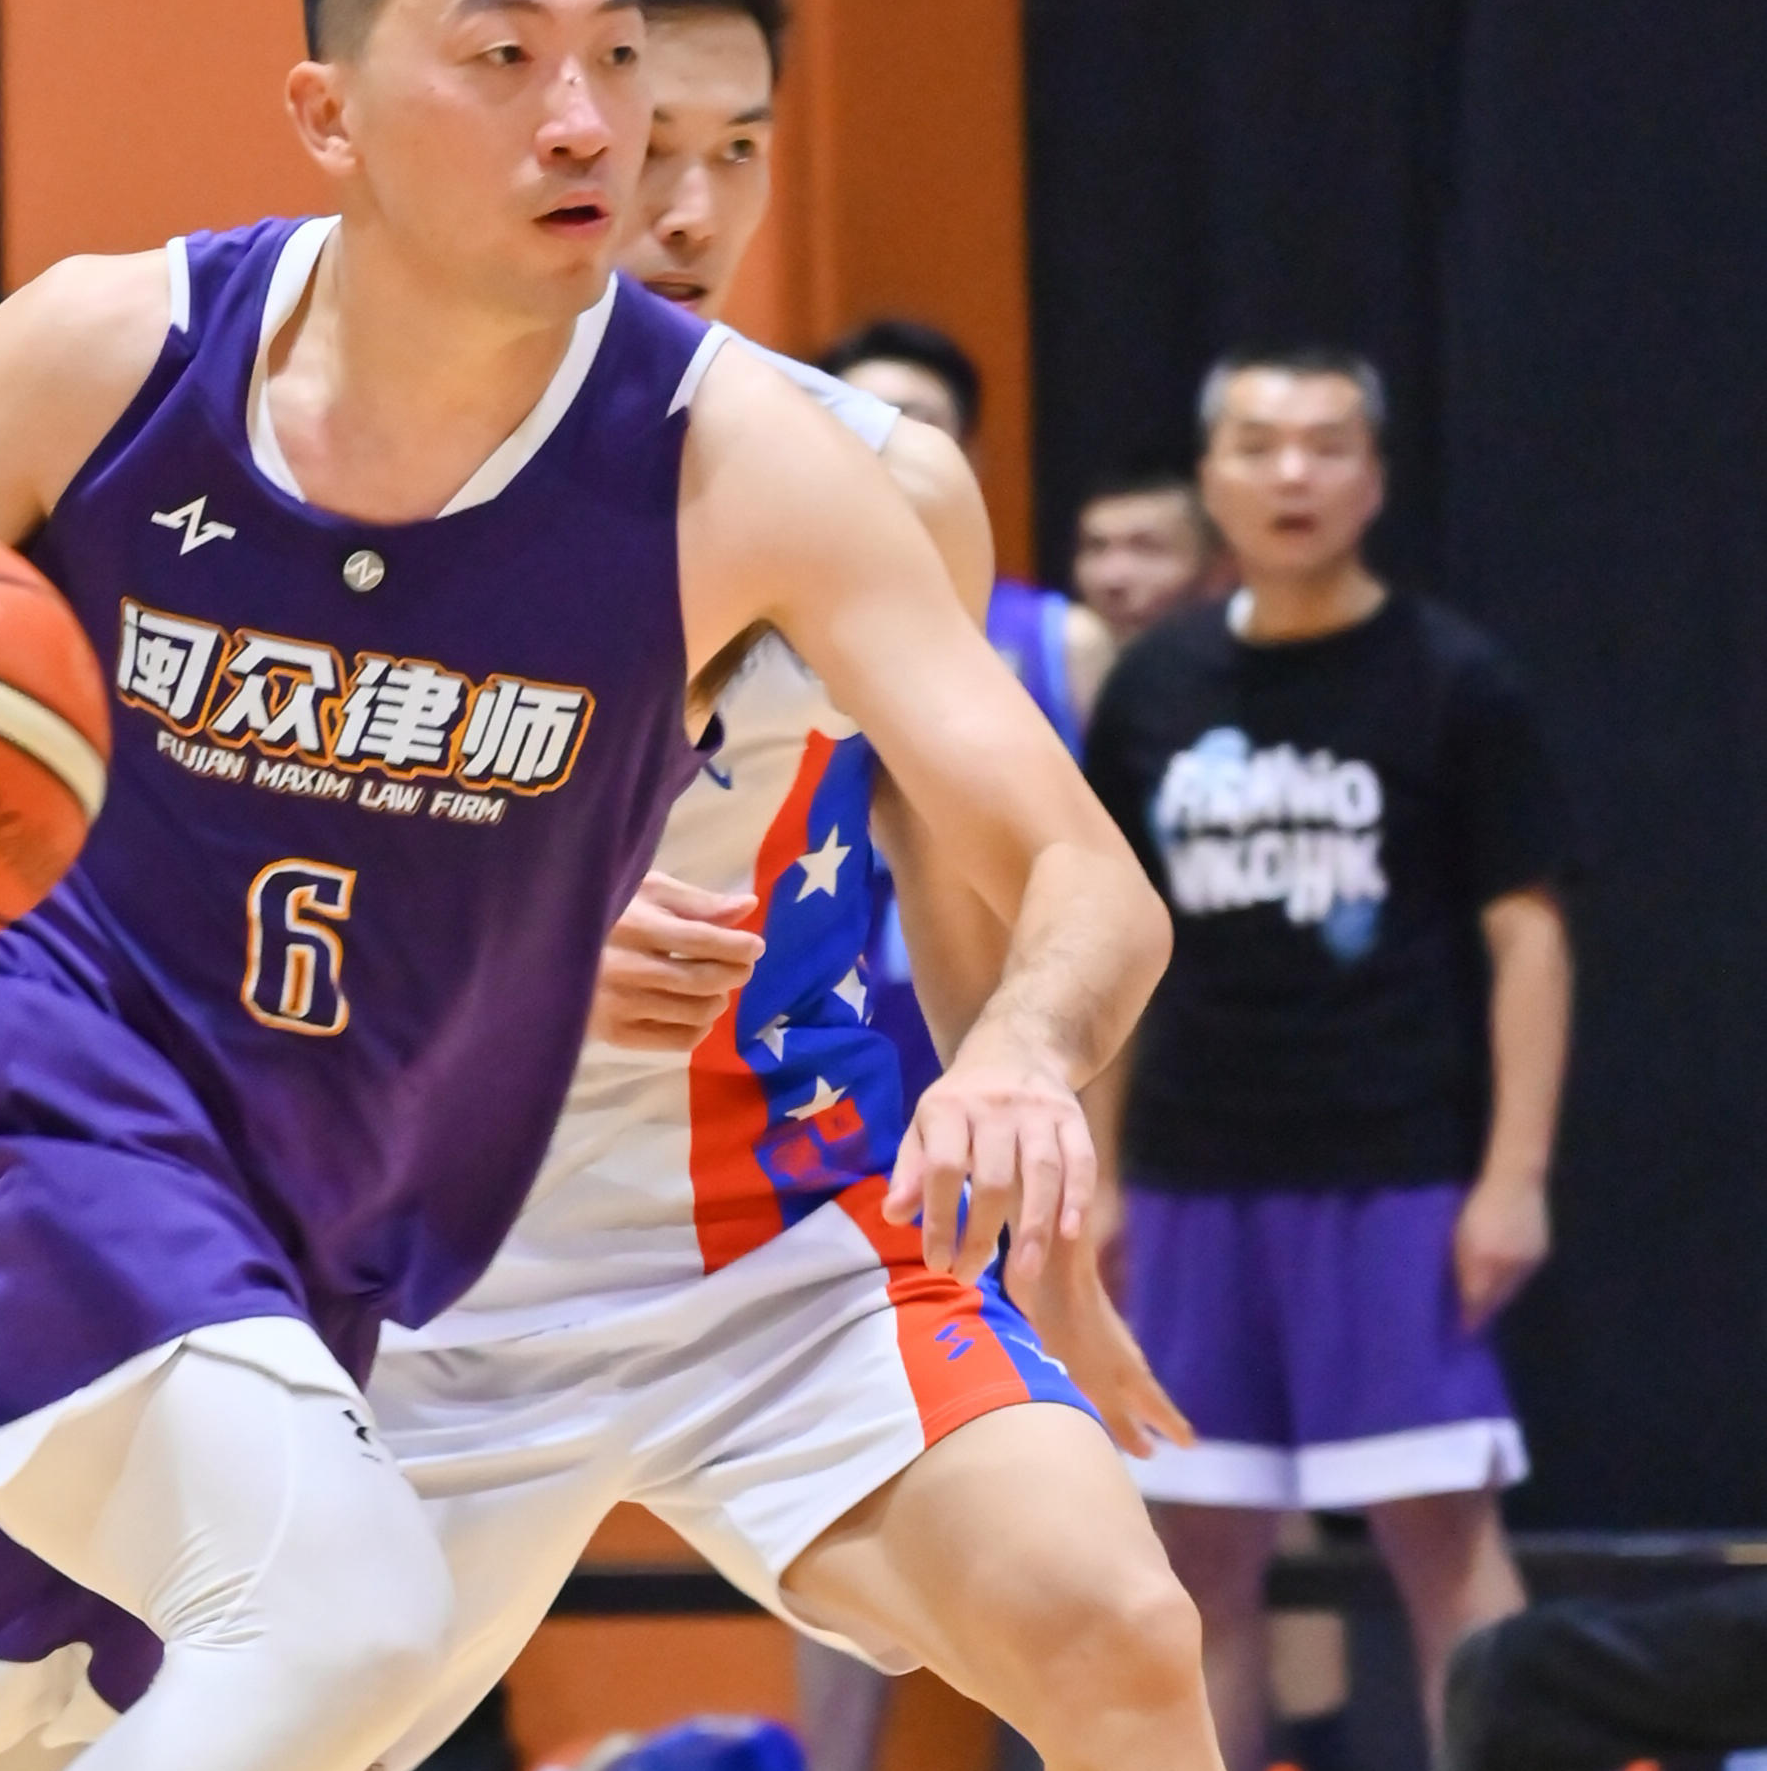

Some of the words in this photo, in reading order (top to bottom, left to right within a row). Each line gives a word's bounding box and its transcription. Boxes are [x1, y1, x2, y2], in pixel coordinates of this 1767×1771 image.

[117, 597, 595, 796] 闽众律师
[156, 730, 247, 783] FUJIAN
[252, 760, 353, 803] MAXIM
[357, 780, 426, 815] LAW
[429, 790, 507, 825] FIRM
[241, 858, 357, 1036] 6
